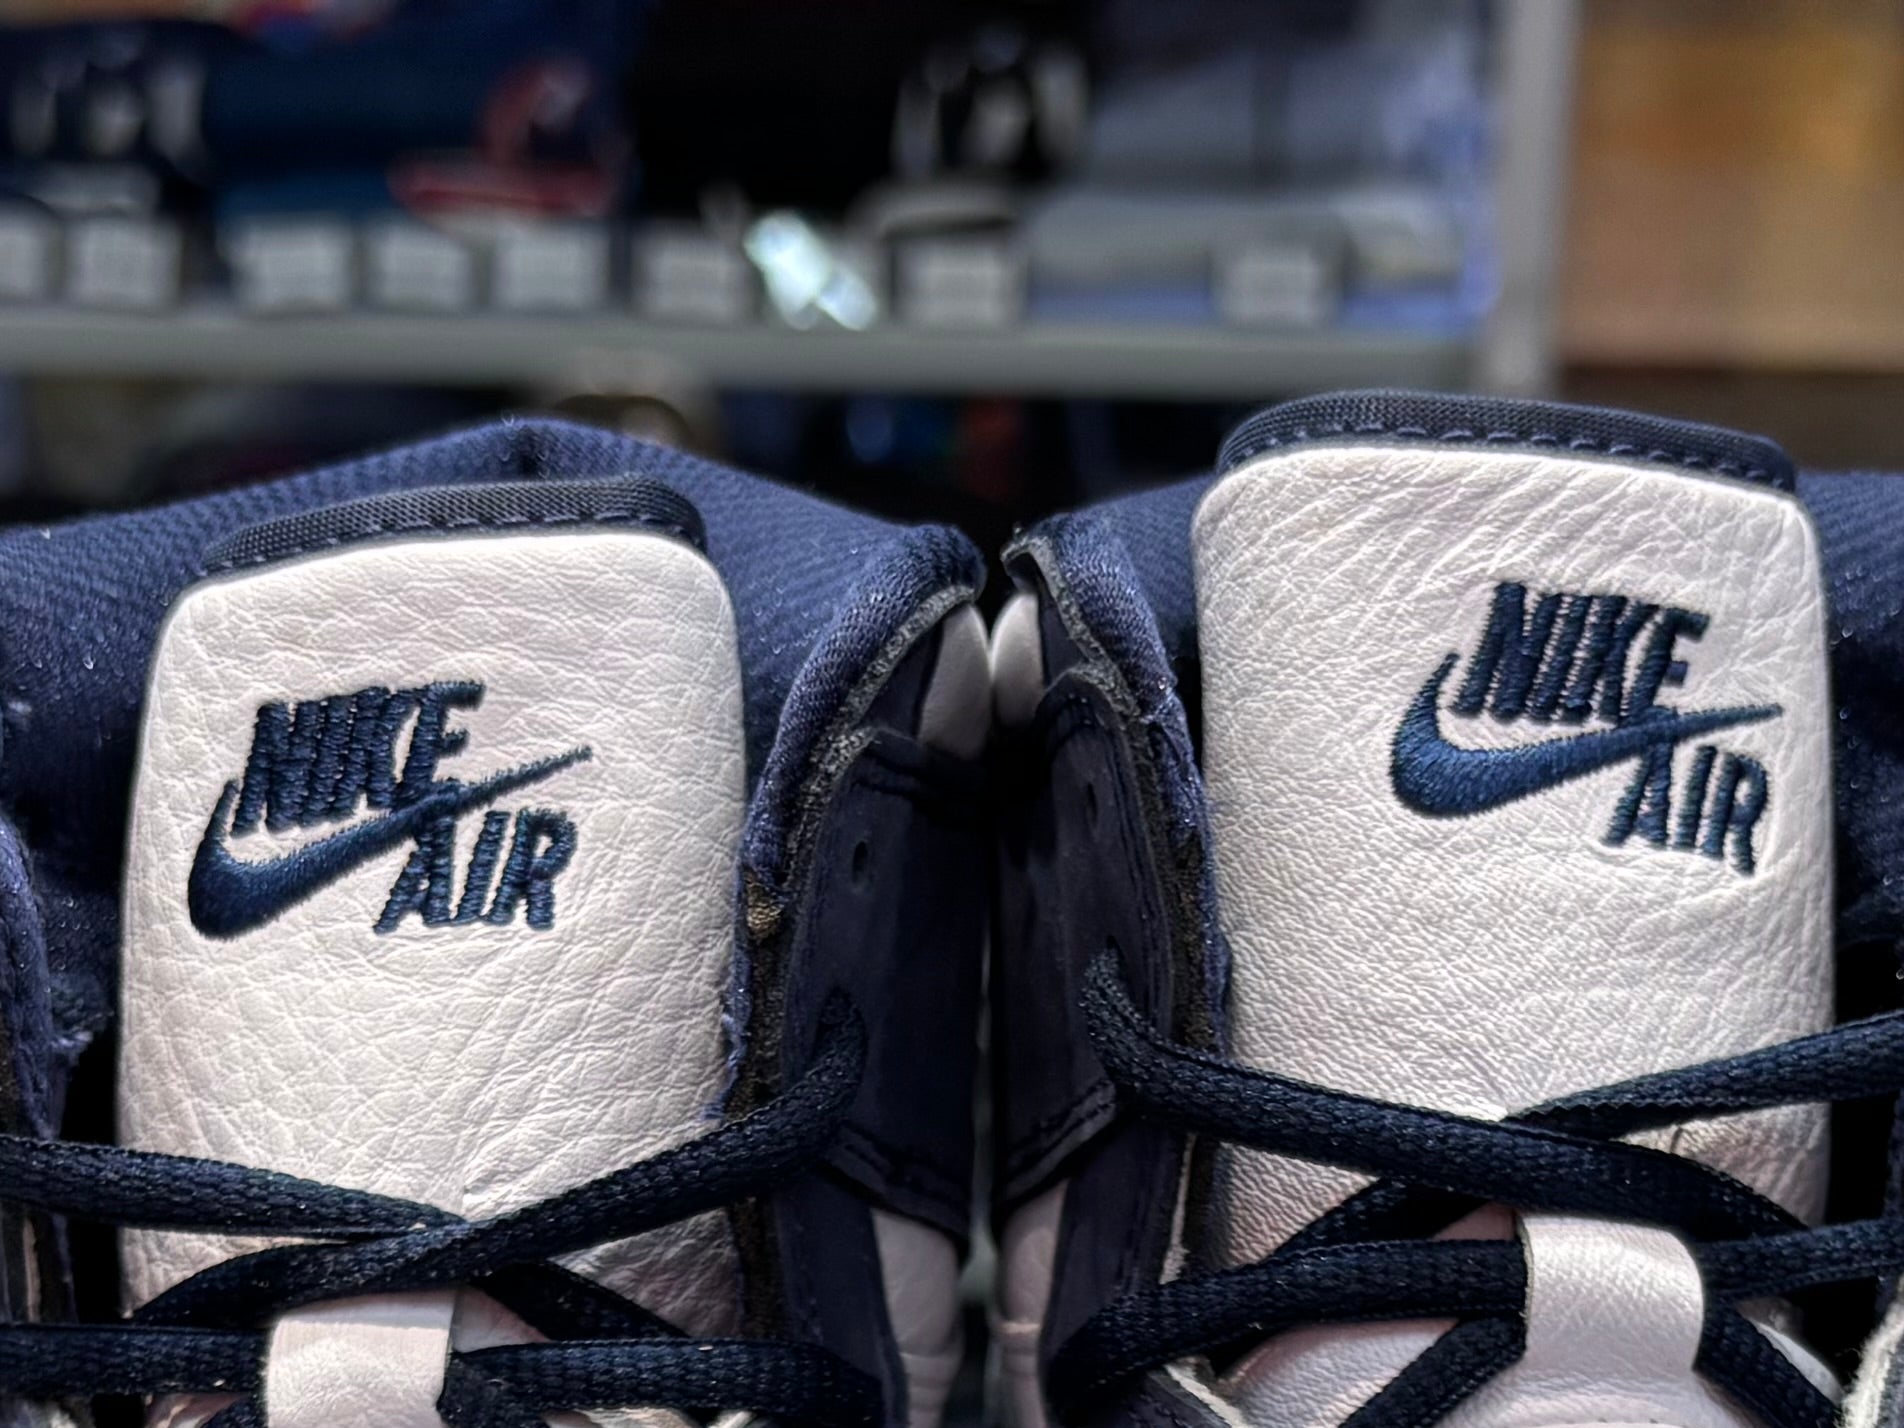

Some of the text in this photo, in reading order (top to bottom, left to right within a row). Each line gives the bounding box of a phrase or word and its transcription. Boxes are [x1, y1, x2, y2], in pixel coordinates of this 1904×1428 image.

[1450, 581, 1709, 728] NIKE
[230, 680, 486, 834] NIKE
[1601, 742, 1769, 875] AIR
[372, 807, 577, 935] AIR
